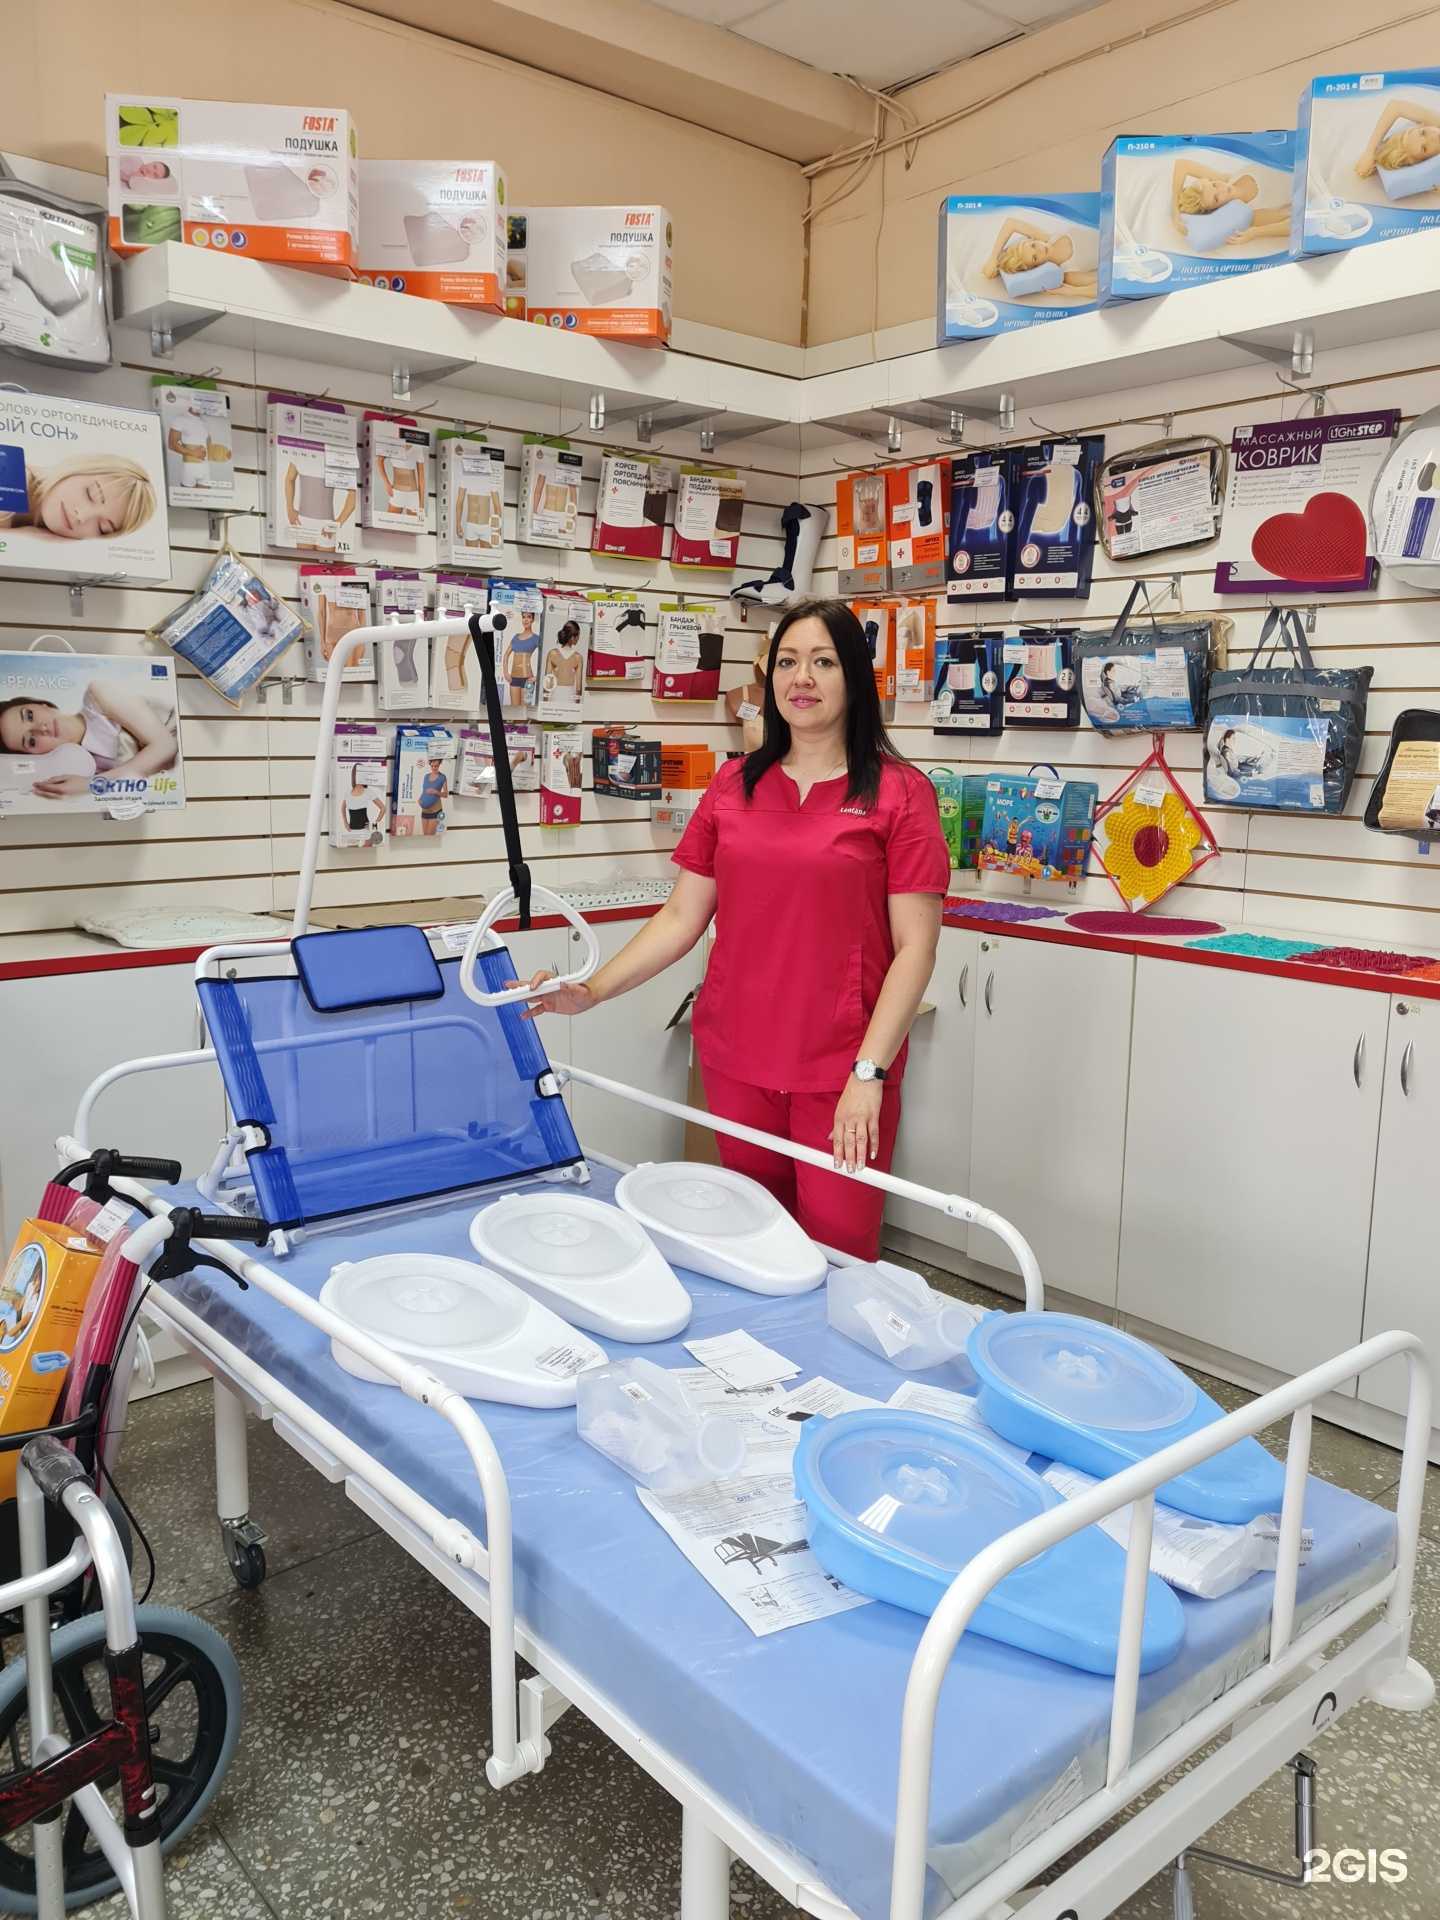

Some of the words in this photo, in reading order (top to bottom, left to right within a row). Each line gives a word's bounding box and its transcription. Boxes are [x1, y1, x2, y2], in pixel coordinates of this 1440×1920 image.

[303, 115, 336, 132] FOSTA
[284, 137, 338, 152] ПОДУШКА
[439, 188, 487, 201] ПОДУШКА
[624, 212, 652, 226] FOSTA
[610, 231, 654, 244] ПОДУШКА
[40, 407, 148, 433] ОРТОПЕДИЧЕСКАЯ
[1240, 427, 1322, 446] МАССАЖНЫЙ
[1237, 444, 1320, 469] КОВРИК
[670, 616, 695, 624] БАНДАЖ
[669, 623, 702, 632] ГРЫЖЕВОЙ
